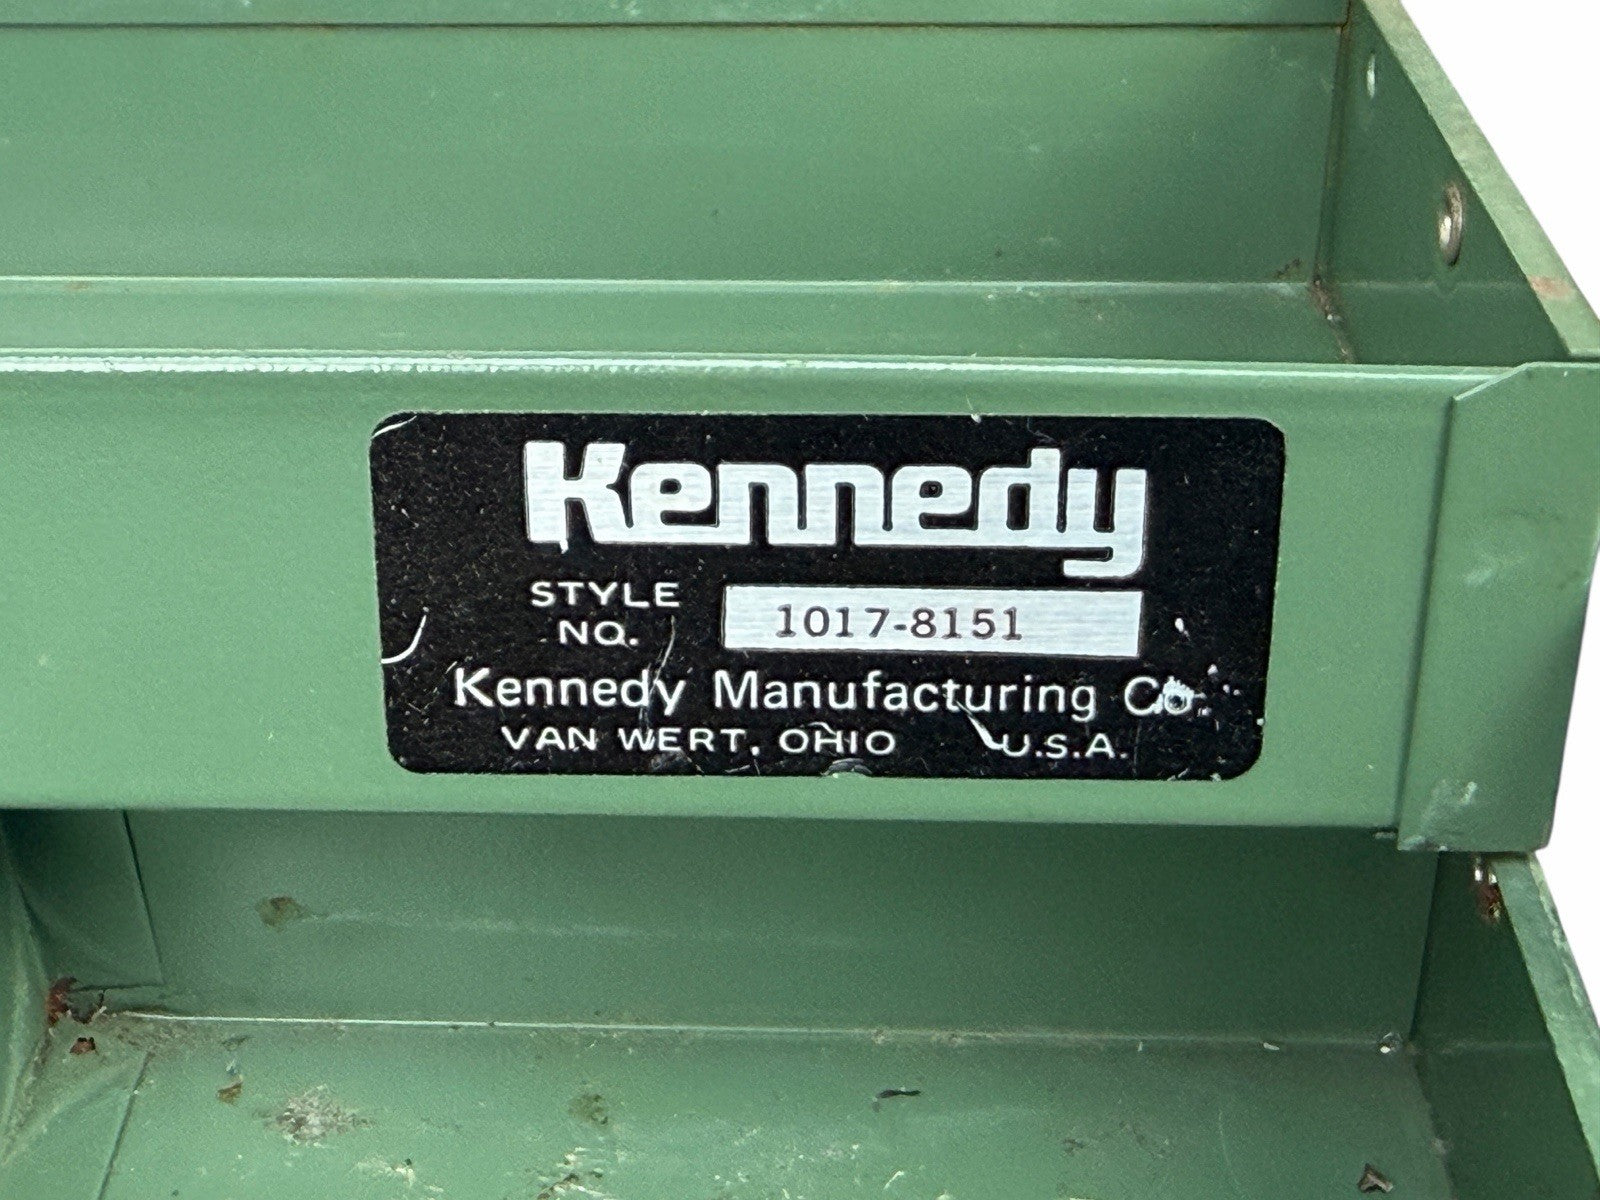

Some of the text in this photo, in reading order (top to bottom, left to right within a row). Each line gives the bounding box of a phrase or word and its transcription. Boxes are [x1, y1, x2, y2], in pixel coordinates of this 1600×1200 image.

[523, 440, 1148, 580] Kennedy
[530, 581, 680, 609] STYLE
[558, 619, 640, 648] NO.
[776, 603, 1023, 641] 1017-8151
[454, 667, 687, 717] Kennedy
[714, 669, 1097, 723] Manufacturing
[500, 725, 598, 751] VAN
[778, 728, 897, 756] OHIO
[1001, 732, 1130, 761] U.S.A.
